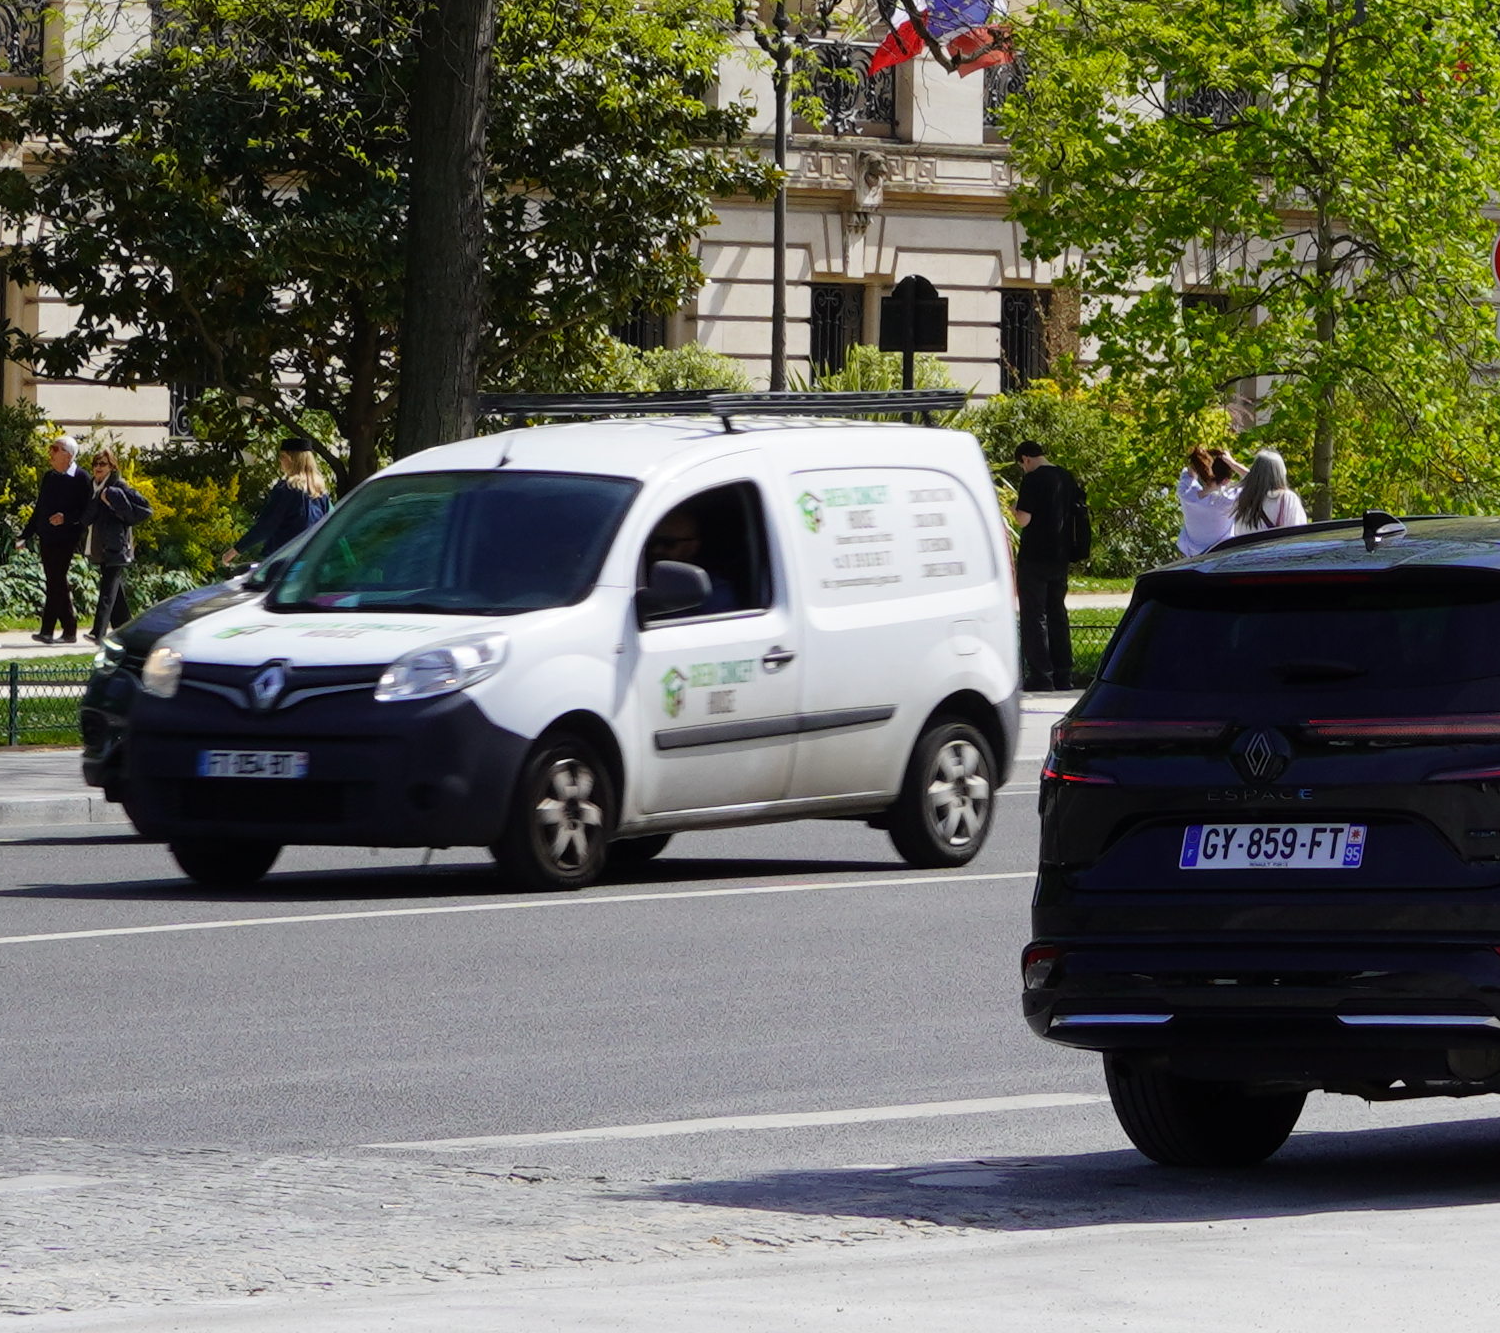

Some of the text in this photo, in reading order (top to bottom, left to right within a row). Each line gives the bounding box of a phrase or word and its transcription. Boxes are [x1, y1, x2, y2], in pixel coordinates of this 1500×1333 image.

[1207, 788, 1313, 801] ESPACE
[1202, 827, 1345, 860] GY-859-FT
[1187, 849, 1193, 858] F
[1345, 846, 1360, 862] 95
